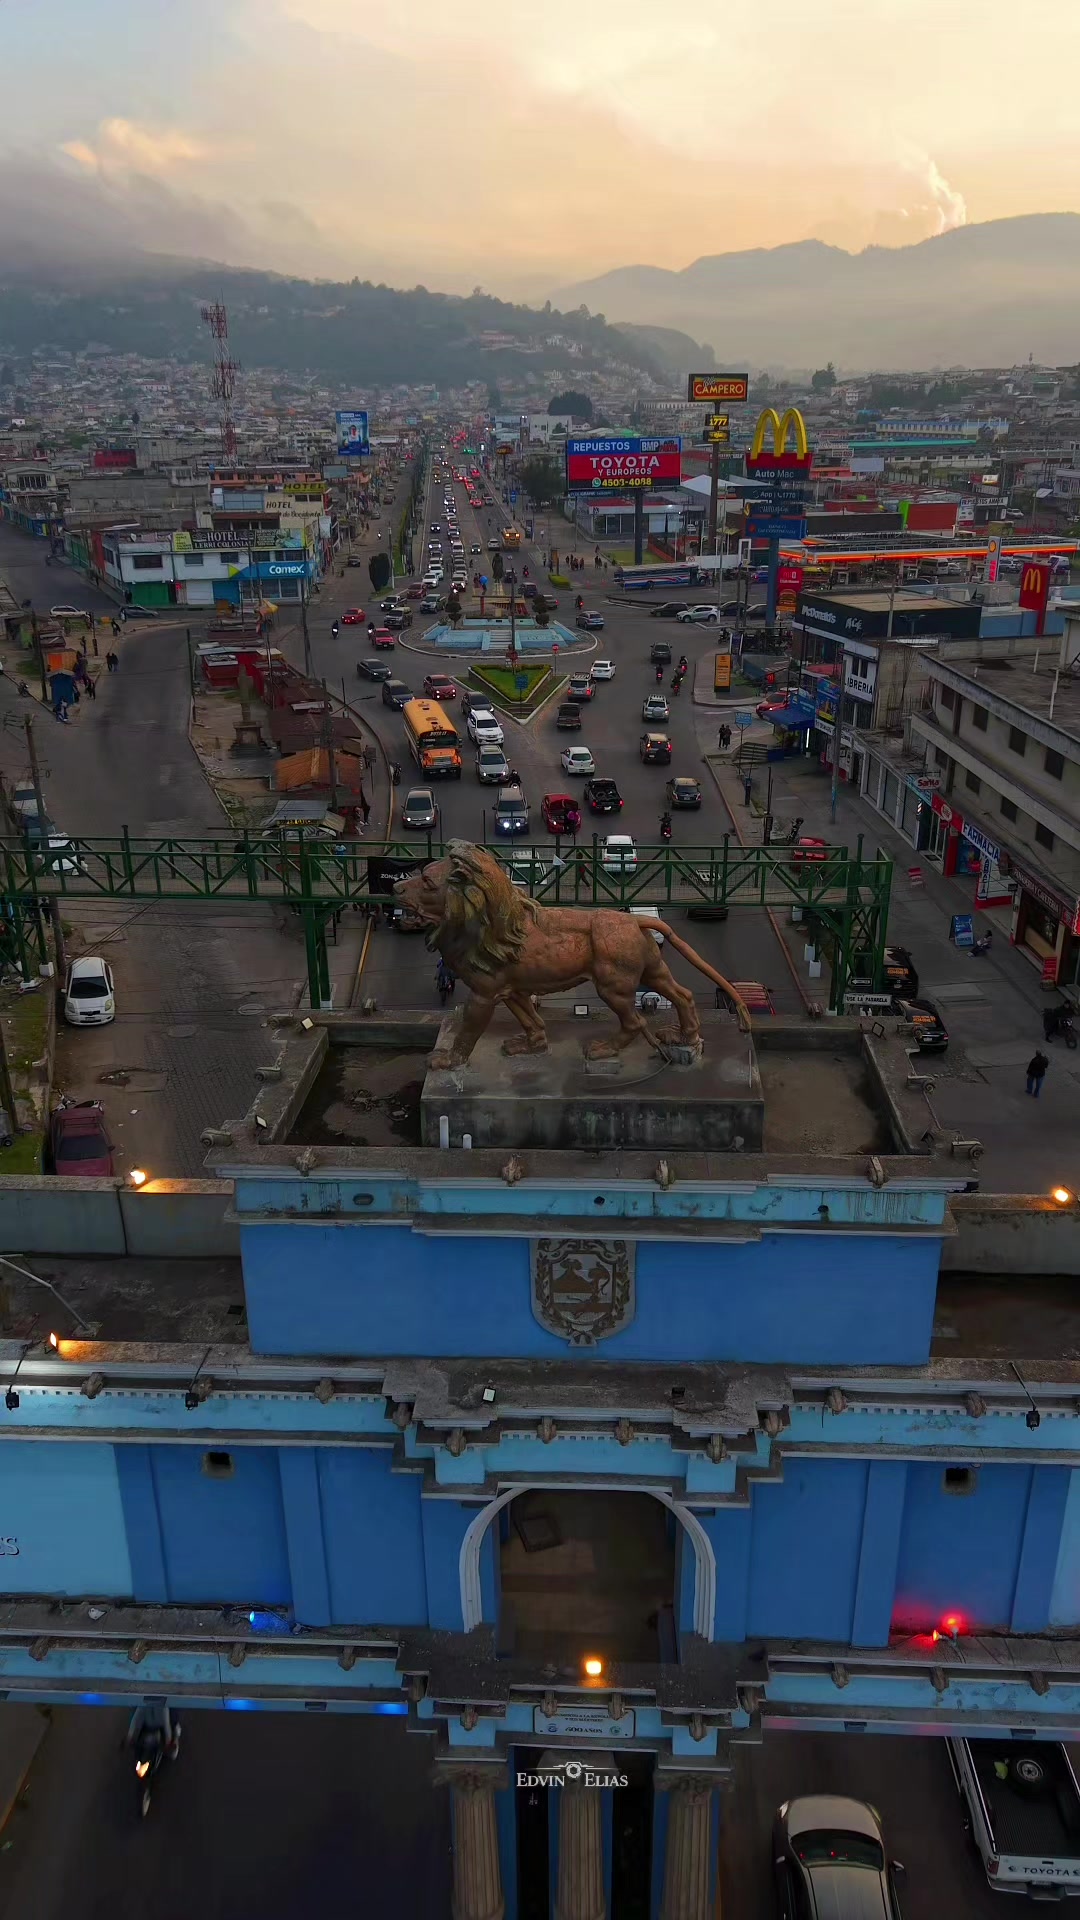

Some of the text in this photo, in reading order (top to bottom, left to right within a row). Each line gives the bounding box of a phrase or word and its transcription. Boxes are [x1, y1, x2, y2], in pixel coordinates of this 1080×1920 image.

[695, 384, 744, 395] CAMPERO
[573, 441, 630, 452] REPUESTOS
[641, 441, 660, 452] BMP
[590, 456, 660, 469] TOYOTA
[598, 467, 652, 477] Y EUROPEOS
[755, 469, 795, 479] Auto Mac
[266, 501, 293, 509] HOTEL
[207, 531, 240, 542] HOTEL
[217, 539, 254, 548] COLONIAL
[917, 779, 940, 787] Sarita
[963, 823, 999, 861] FARMACIA
[1023, 1867, 1070, 1877] TOYOTA
